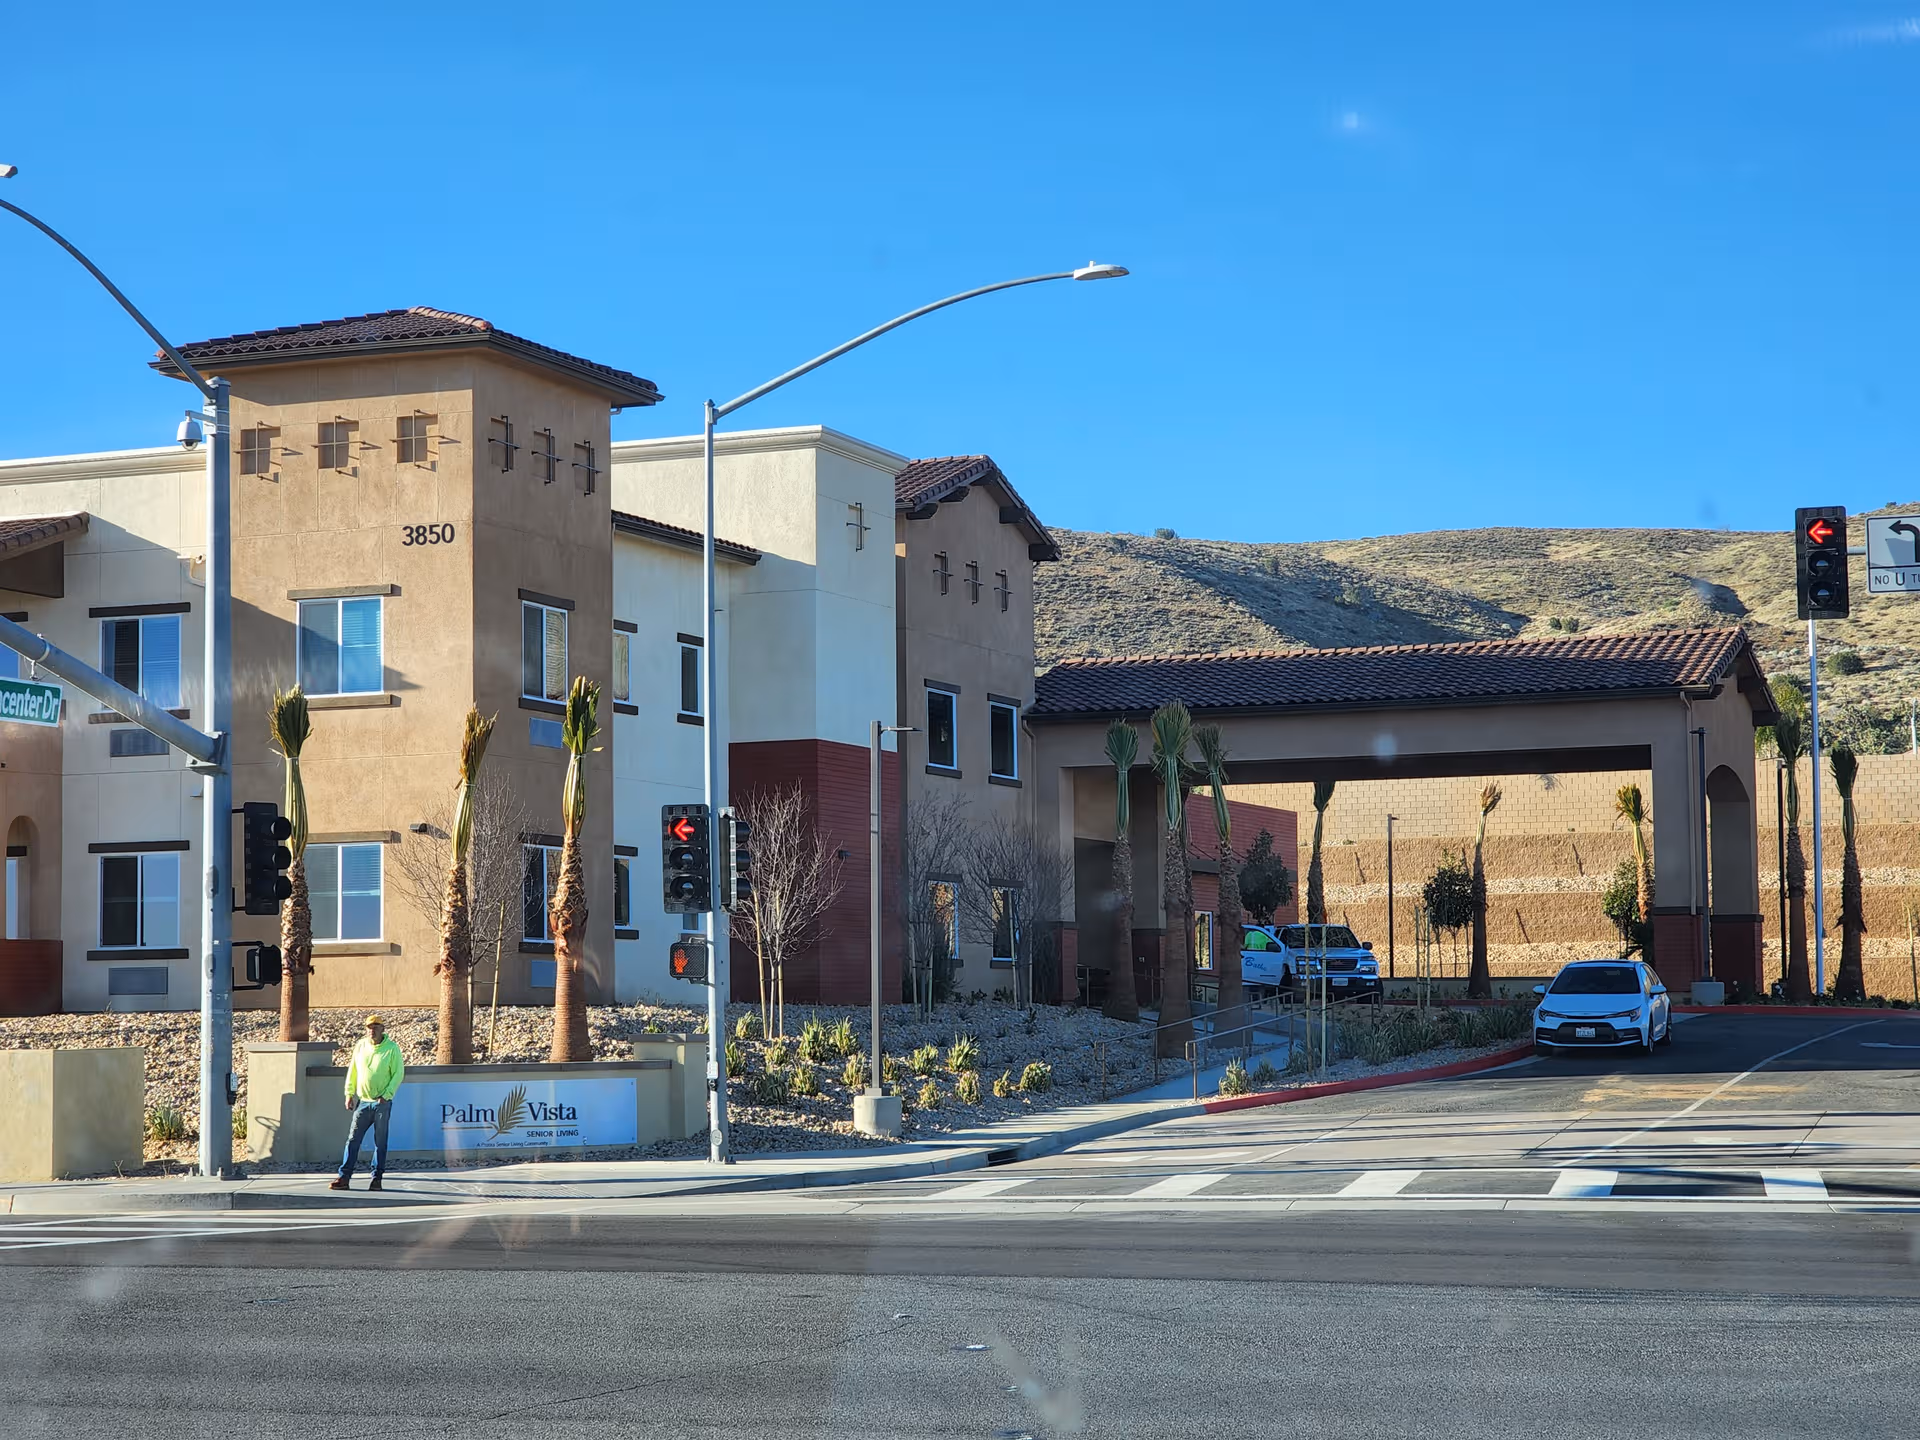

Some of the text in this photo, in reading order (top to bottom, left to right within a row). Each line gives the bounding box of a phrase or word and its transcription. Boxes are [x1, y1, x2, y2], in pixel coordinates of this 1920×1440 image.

[402, 523, 455, 546] 3850
[1874, 572, 1920, 586] NO U T
[42, 689, 59, 720] Dr
[440, 1101, 578, 1124] Palm Vista
[526, 1129, 579, 1138] SENIOR LIVING
